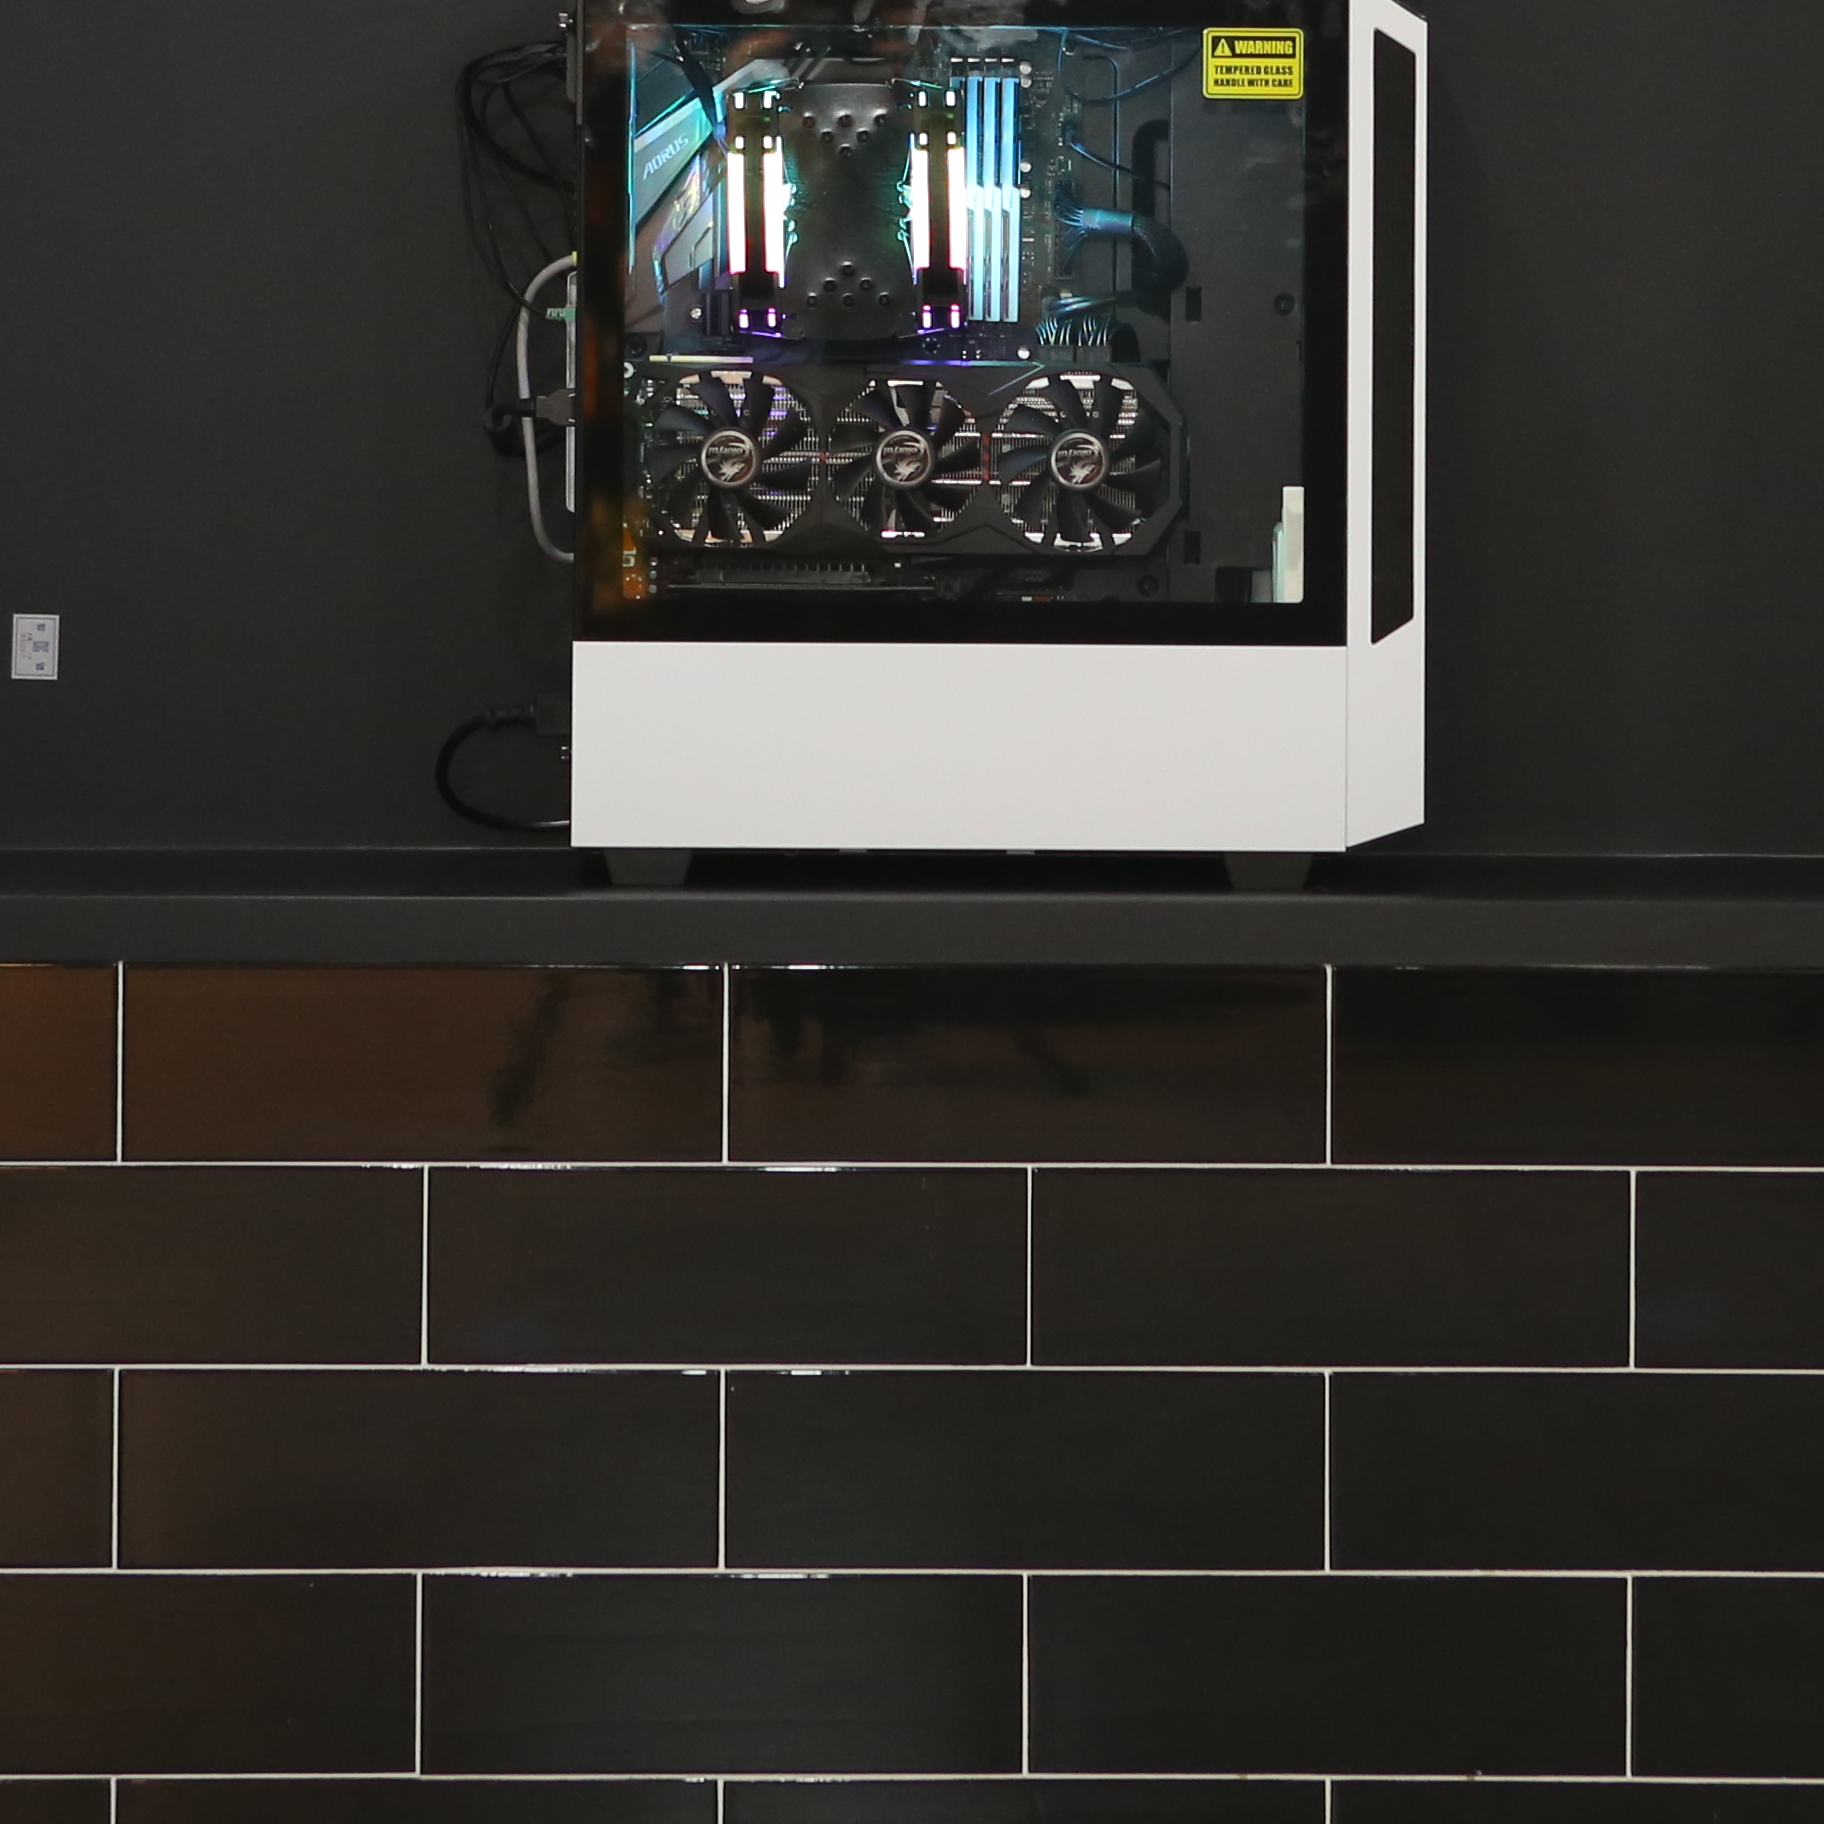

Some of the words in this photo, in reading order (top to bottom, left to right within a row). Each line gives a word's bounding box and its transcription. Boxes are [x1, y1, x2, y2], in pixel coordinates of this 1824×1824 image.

[1234, 40, 1294, 55] WARNING
[1214, 65, 1262, 75] TEMPERED
[1263, 65, 1293, 75] GLASS
[1213, 78, 1245, 87] HANDLE
[1247, 78, 1270, 87] WITH
[1271, 78, 1293, 88] CARE
[643, 133, 689, 180] AORUS
